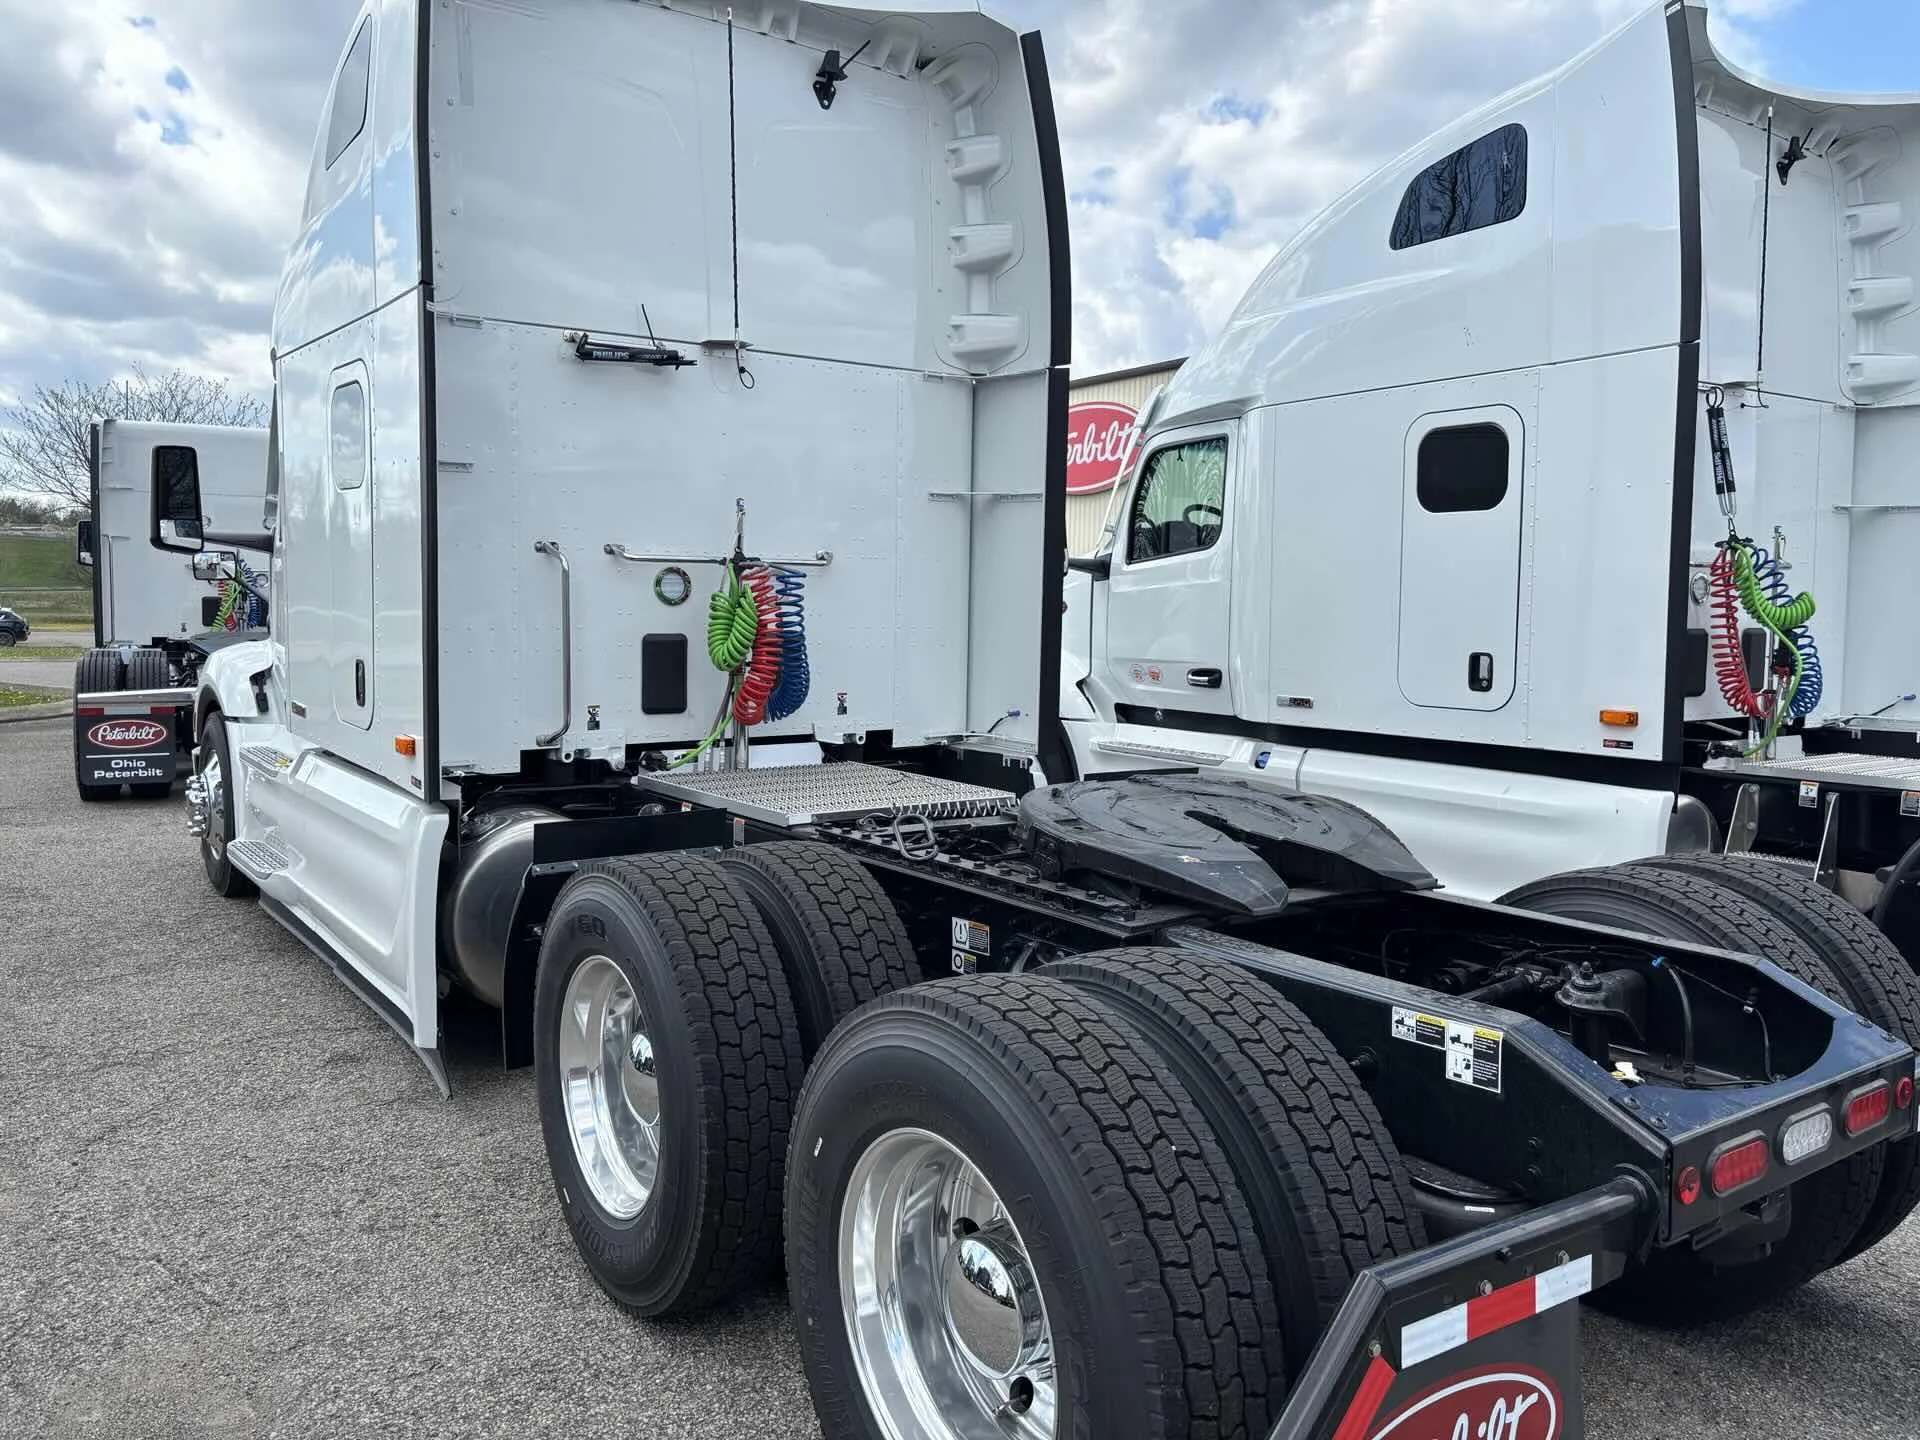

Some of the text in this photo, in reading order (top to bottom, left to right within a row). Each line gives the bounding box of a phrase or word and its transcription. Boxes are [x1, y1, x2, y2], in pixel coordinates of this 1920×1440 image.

[98, 725, 161, 742] Peterbilt
[111, 759, 146, 769] Ohio
[94, 767, 163, 779] Peterbilt
